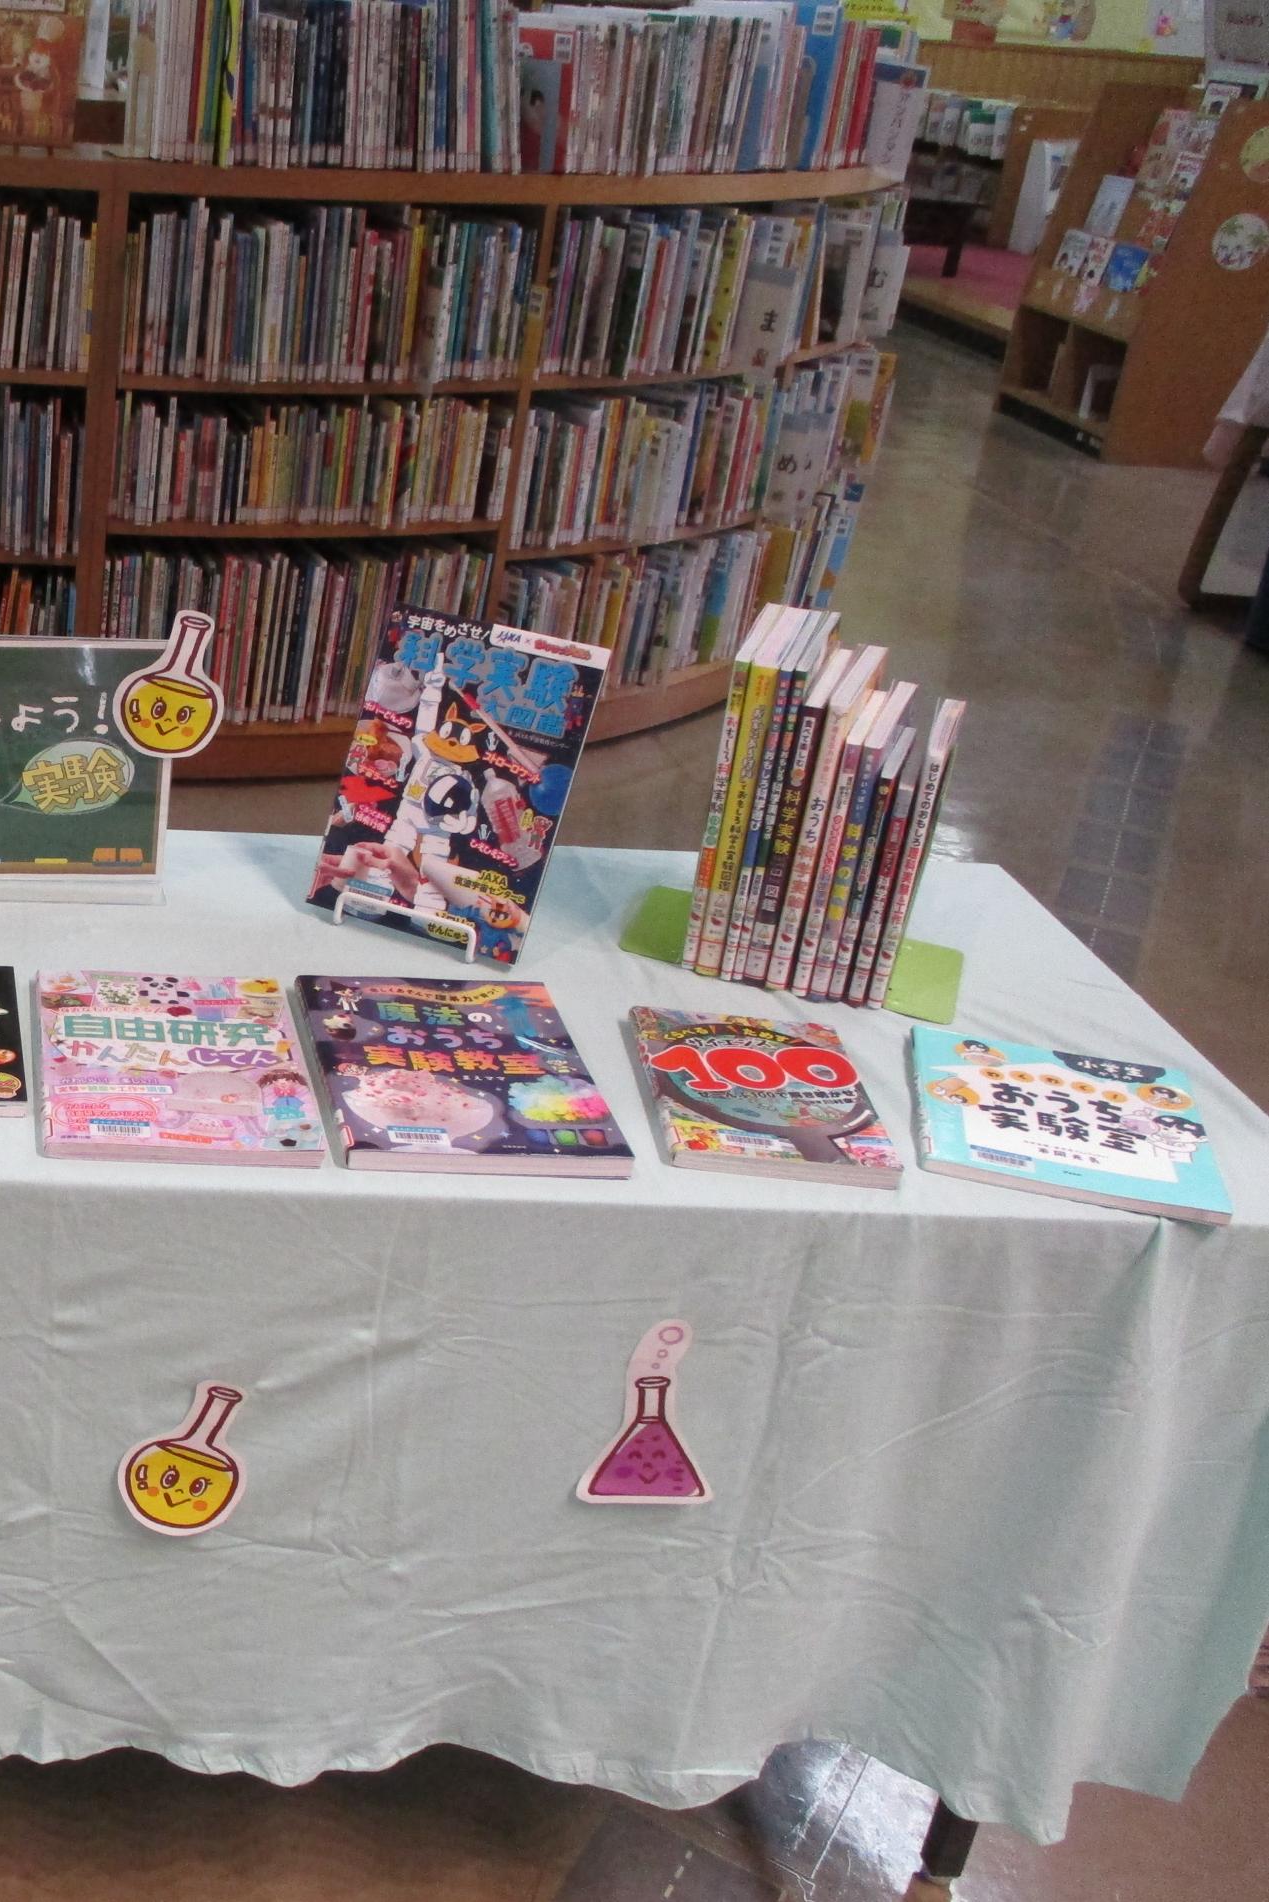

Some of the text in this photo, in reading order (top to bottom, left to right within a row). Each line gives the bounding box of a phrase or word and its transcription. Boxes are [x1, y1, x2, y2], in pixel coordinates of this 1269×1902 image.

[760, 308, 777, 333] ま
[776, 453, 797, 475] め
[398, 631, 578, 712] 科学実験
[21, 747, 130, 815] 実験
[478, 869, 508, 887] JAXA
[376, 1001, 493, 1027] 魔法の
[63, 1014, 275, 1047] 自由研究
[387, 1025, 504, 1050] おうち
[363, 1044, 546, 1076] 実験教室
[650, 1043, 861, 1092] 100
[988, 1081, 1124, 1124] おうち
[977, 1102, 1147, 1155] 実験室
